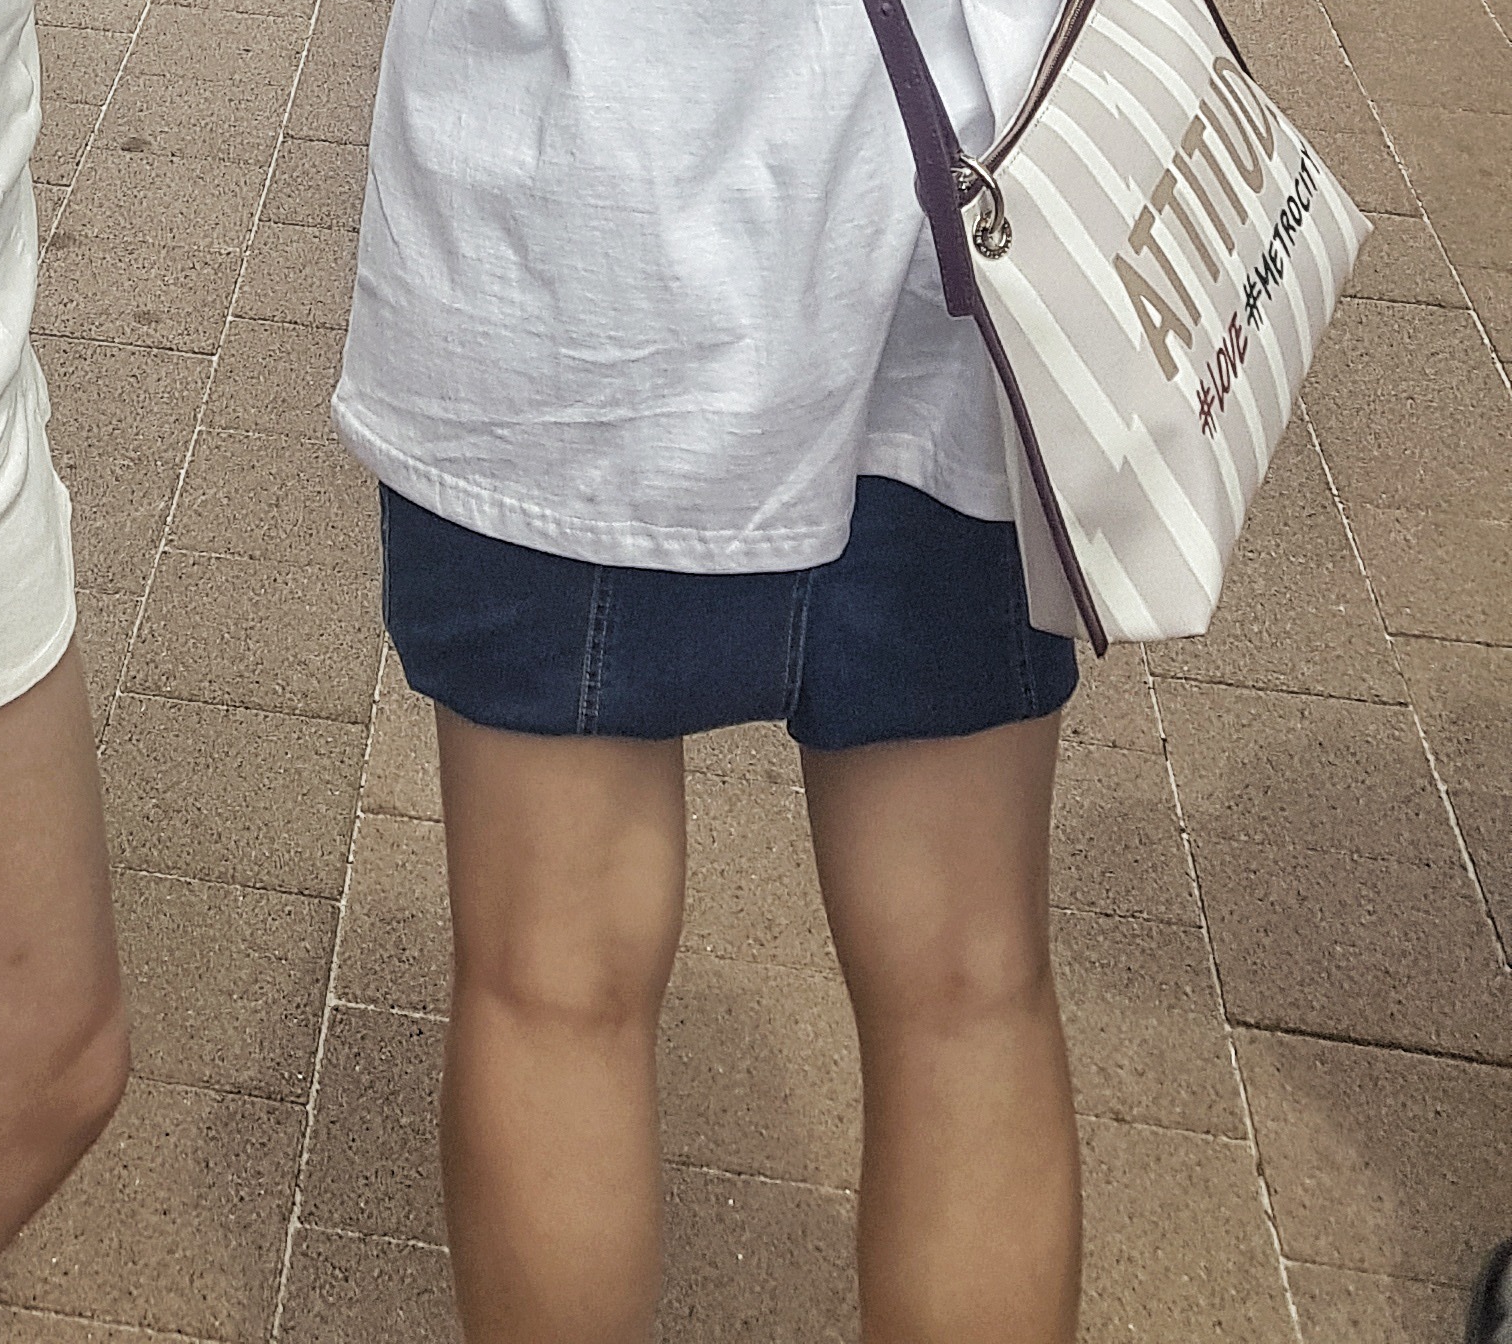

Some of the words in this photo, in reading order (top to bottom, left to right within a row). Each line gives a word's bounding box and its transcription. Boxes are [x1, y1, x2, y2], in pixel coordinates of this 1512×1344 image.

[1112, 55, 1281, 382] ATTITUD
[1196, 310, 1249, 440] #LOVE
[1243, 139, 1321, 332] #METROCITY
